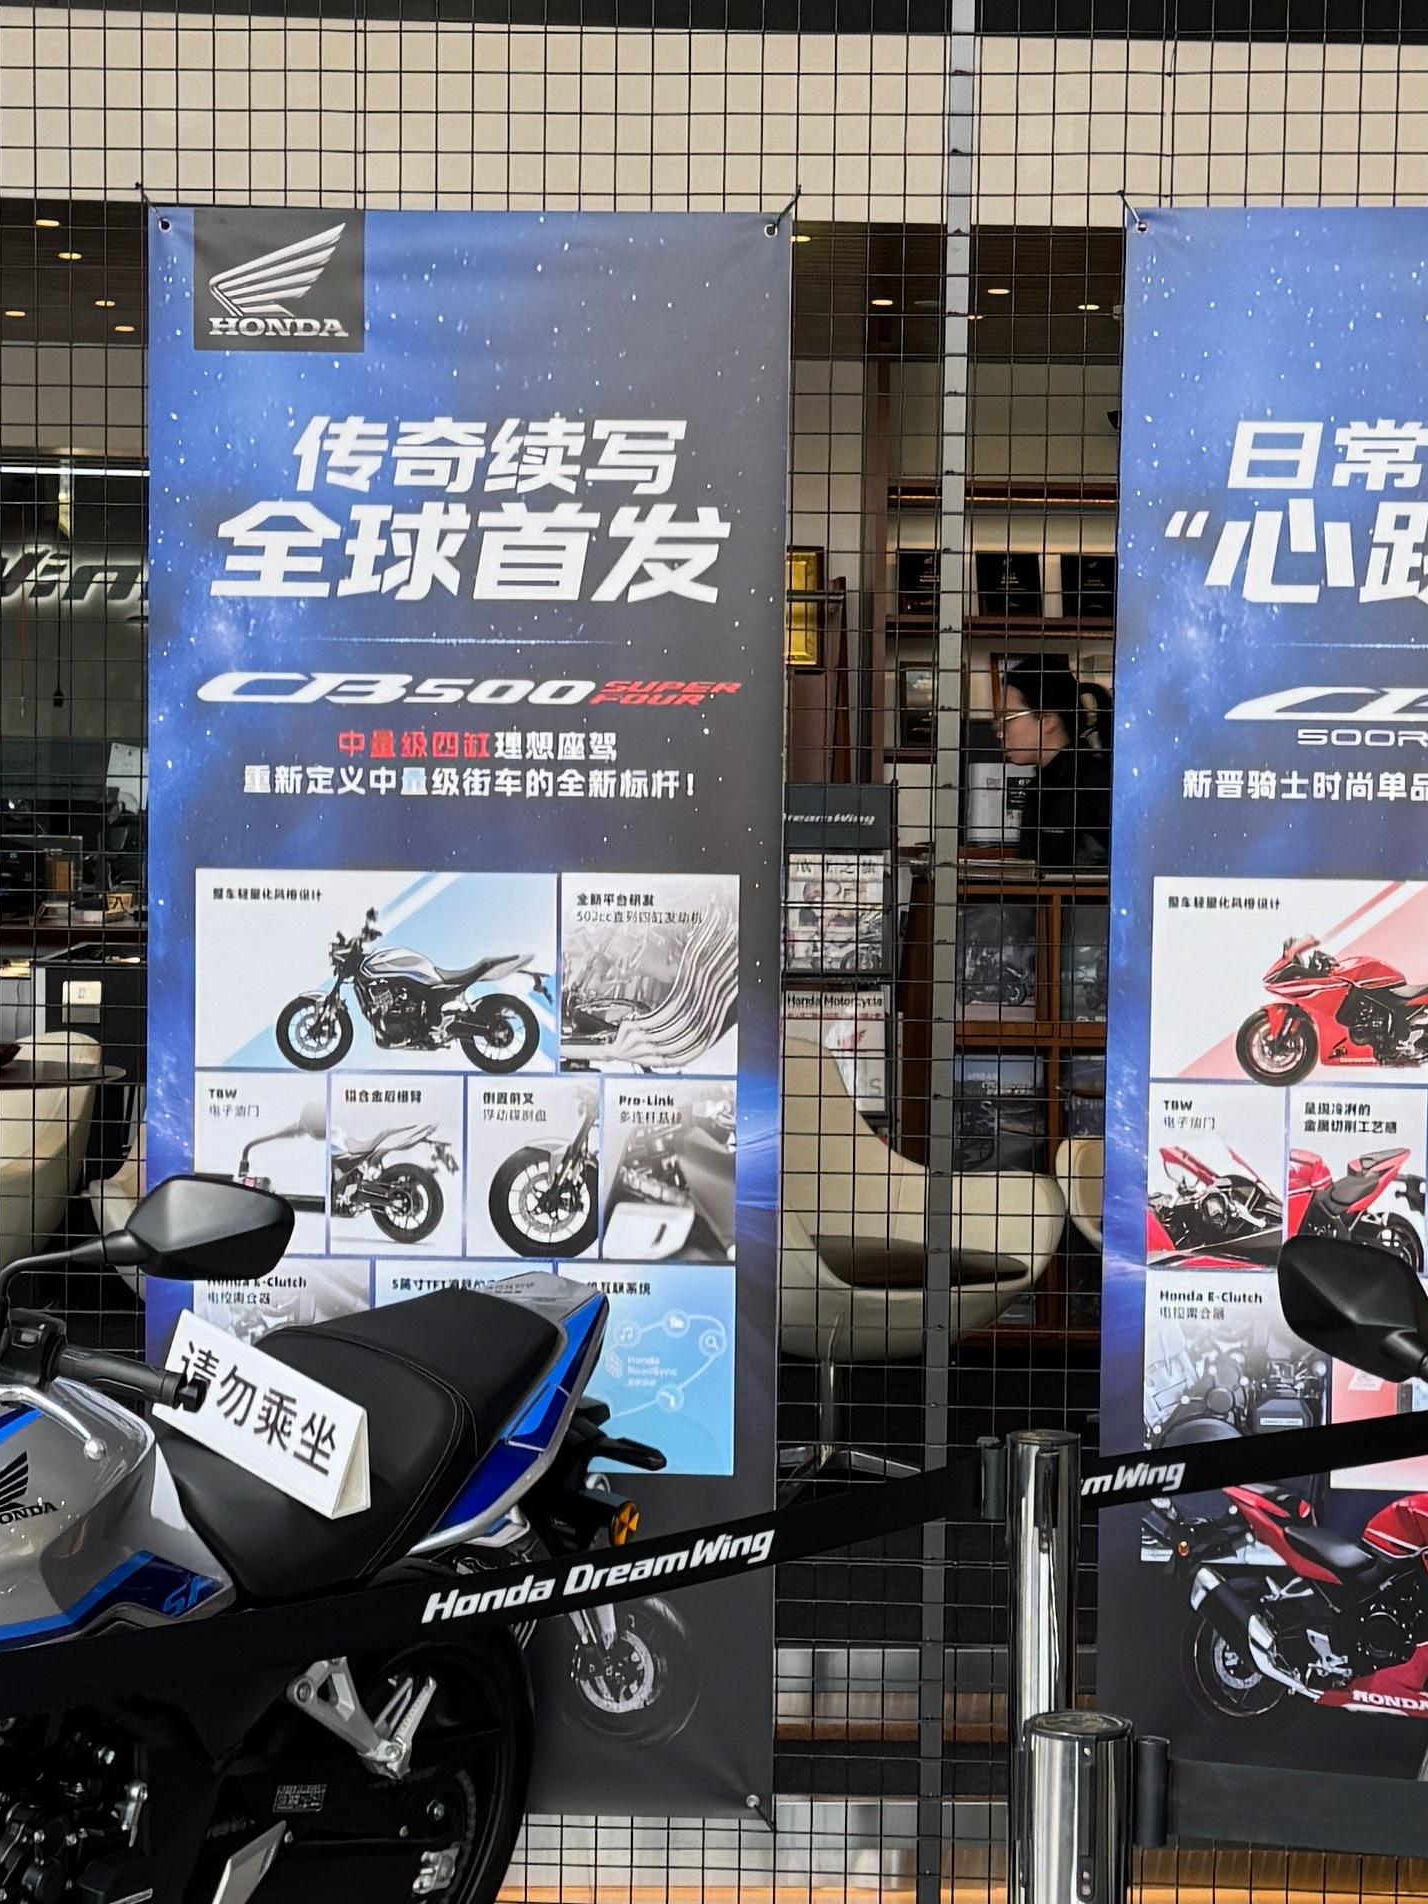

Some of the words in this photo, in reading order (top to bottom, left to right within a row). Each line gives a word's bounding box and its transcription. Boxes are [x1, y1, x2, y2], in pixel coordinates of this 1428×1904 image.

[208, 317, 350, 337] HONDA
[292, 413, 687, 495] 传奇续写
[208, 499, 732, 604] 全球首发
[588, 693, 705, 707] FOUR
[603, 679, 743, 695] SUPER
[336, 731, 619, 760] 中量级四缸理想座驾
[1159, 1289, 1204, 1303] Honda
[1207, 1290, 1263, 1305] E-Clutch
[180, 1340, 339, 1477] 请勿乘坐
[420, 1578, 557, 1626] Honda
